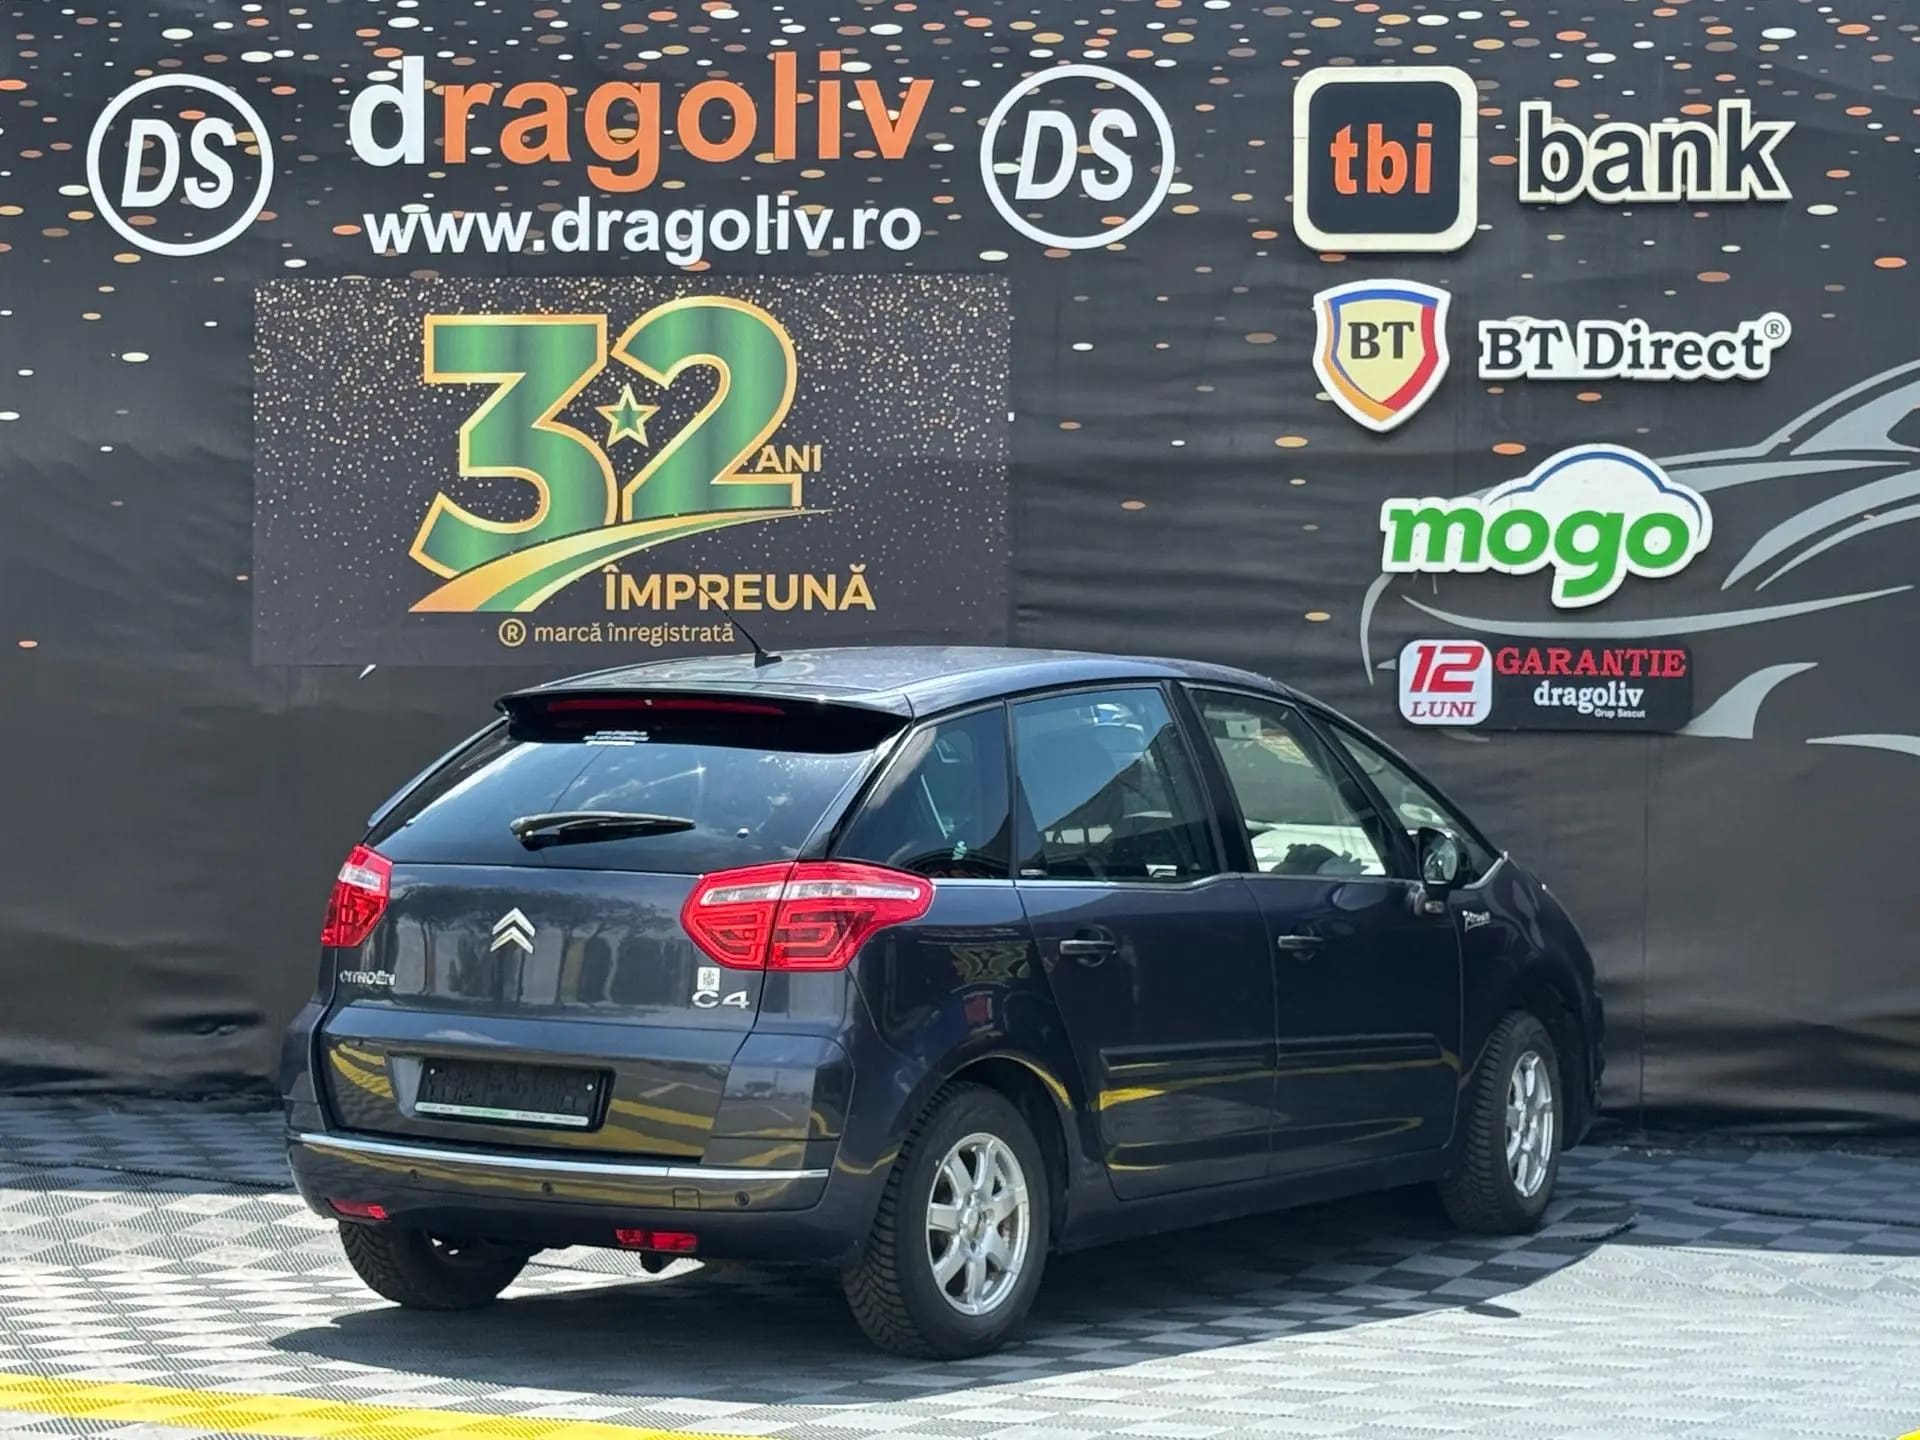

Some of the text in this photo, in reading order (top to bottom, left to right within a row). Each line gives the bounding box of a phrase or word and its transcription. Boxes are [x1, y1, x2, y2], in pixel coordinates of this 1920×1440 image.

[349, 50, 934, 192] dragoliv
[120, 117, 238, 209] DS
[1014, 108, 1138, 201] DS
[1330, 98, 1796, 204] tbi bank
[363, 194, 922, 266] www.dragoliv.ro
[1348, 319, 1415, 360] BT
[1485, 325, 1563, 371] BT
[755, 445, 823, 473] ANI
[1389, 507, 1691, 599] mogo
[601, 564, 877, 612] ÎMPREUNĂ
[534, 623, 602, 643] marcă
[607, 622, 735, 647] înregistrată
[1409, 646, 1484, 692] 12
[1496, 648, 1687, 677] GARANTIE
[1410, 701, 1477, 717] LUNI
[1533, 680, 1644, 714] dragoliv
[692, 990, 751, 1009] C4
